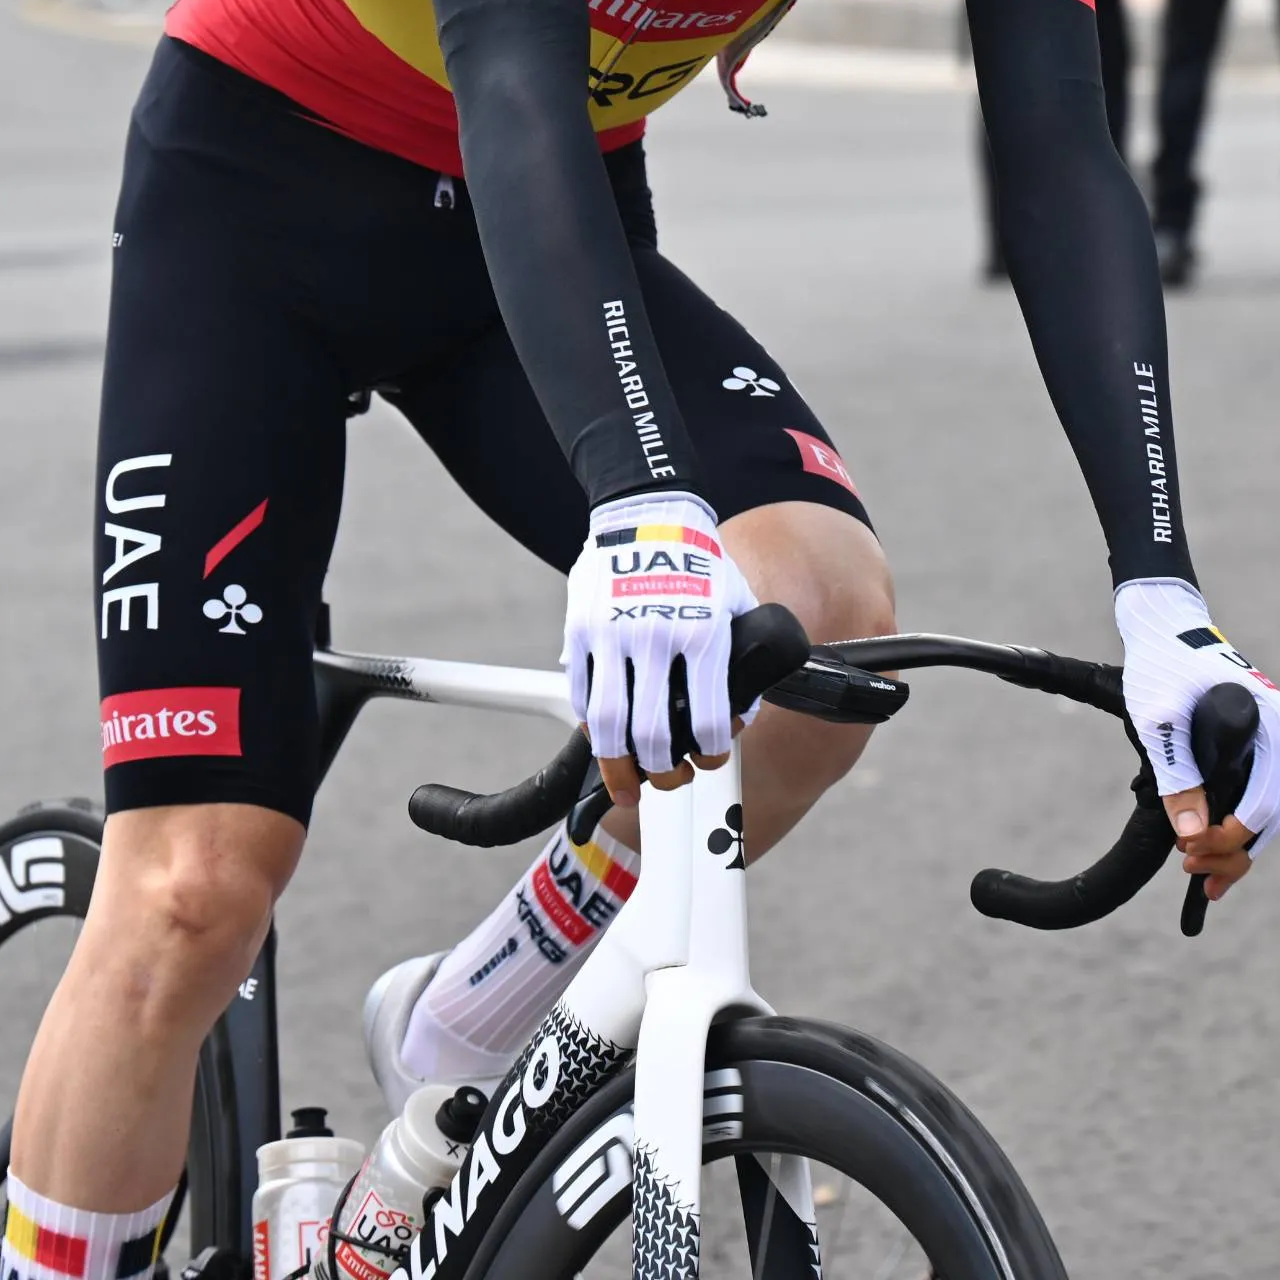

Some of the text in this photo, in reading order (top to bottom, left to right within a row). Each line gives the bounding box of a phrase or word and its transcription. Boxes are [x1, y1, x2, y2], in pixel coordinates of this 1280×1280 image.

[603, 300, 676, 479] RICHARD MILLE
[1134, 361, 1172, 544] RICHARD MILLE
[102, 454, 173, 640] UAE
[611, 551, 712, 577] UAE
[610, 604, 713, 622] XRG
[869, 681, 896, 691] wahoo
[549, 837, 618, 929] UAE
[515, 887, 568, 965] XRG
